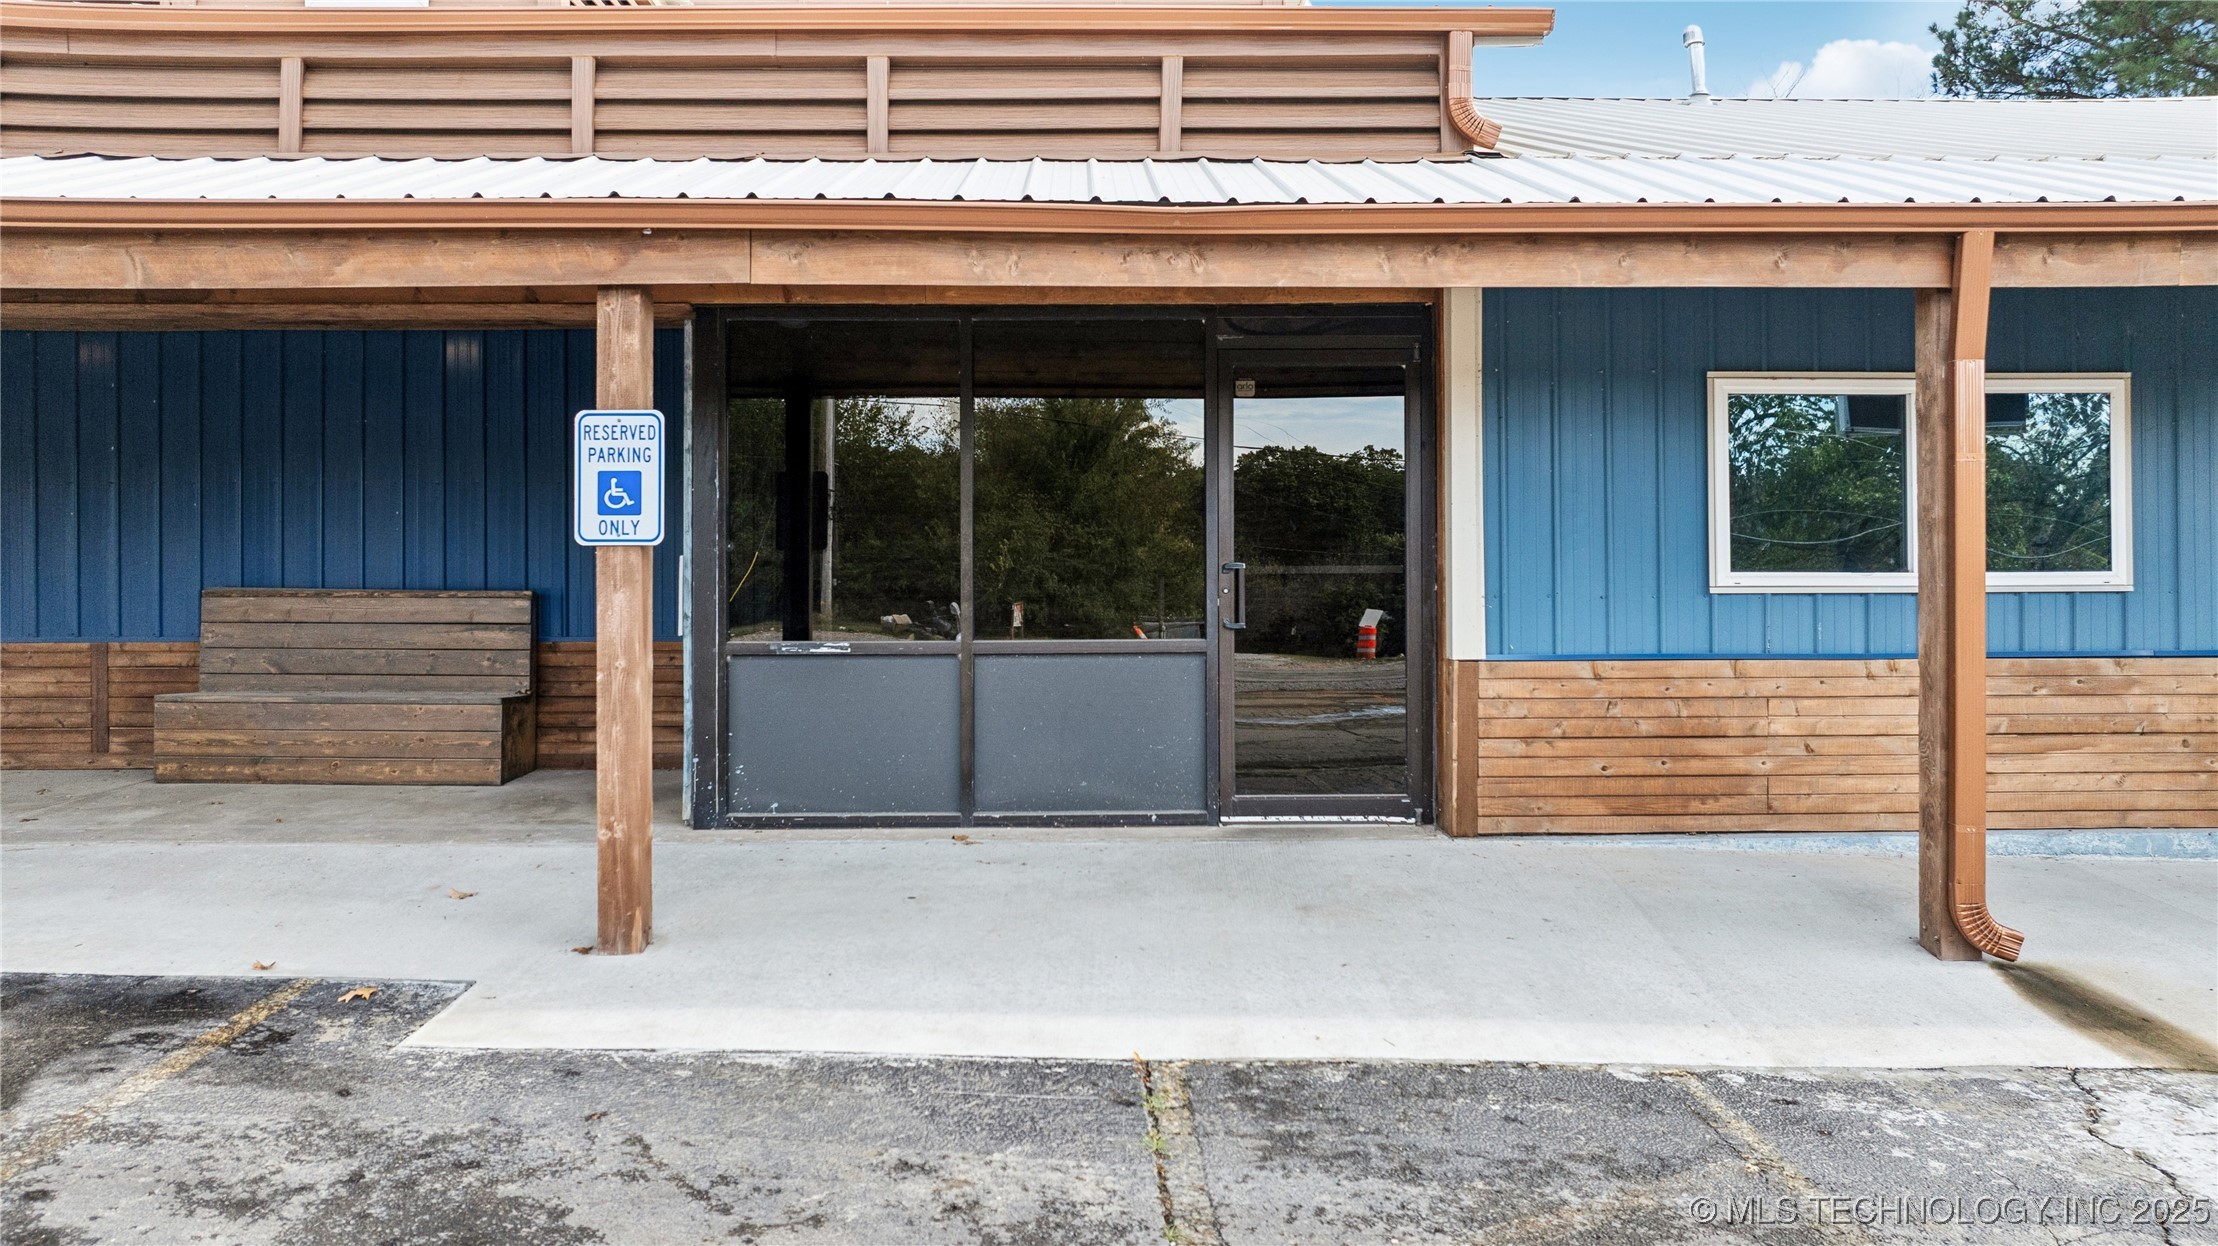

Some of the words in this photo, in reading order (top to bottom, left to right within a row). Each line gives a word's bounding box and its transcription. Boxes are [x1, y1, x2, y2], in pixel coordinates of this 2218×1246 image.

[583, 425, 656, 440] RESERVED
[588, 447, 652, 462] PARKING
[598, 520, 640, 535] ONLY
